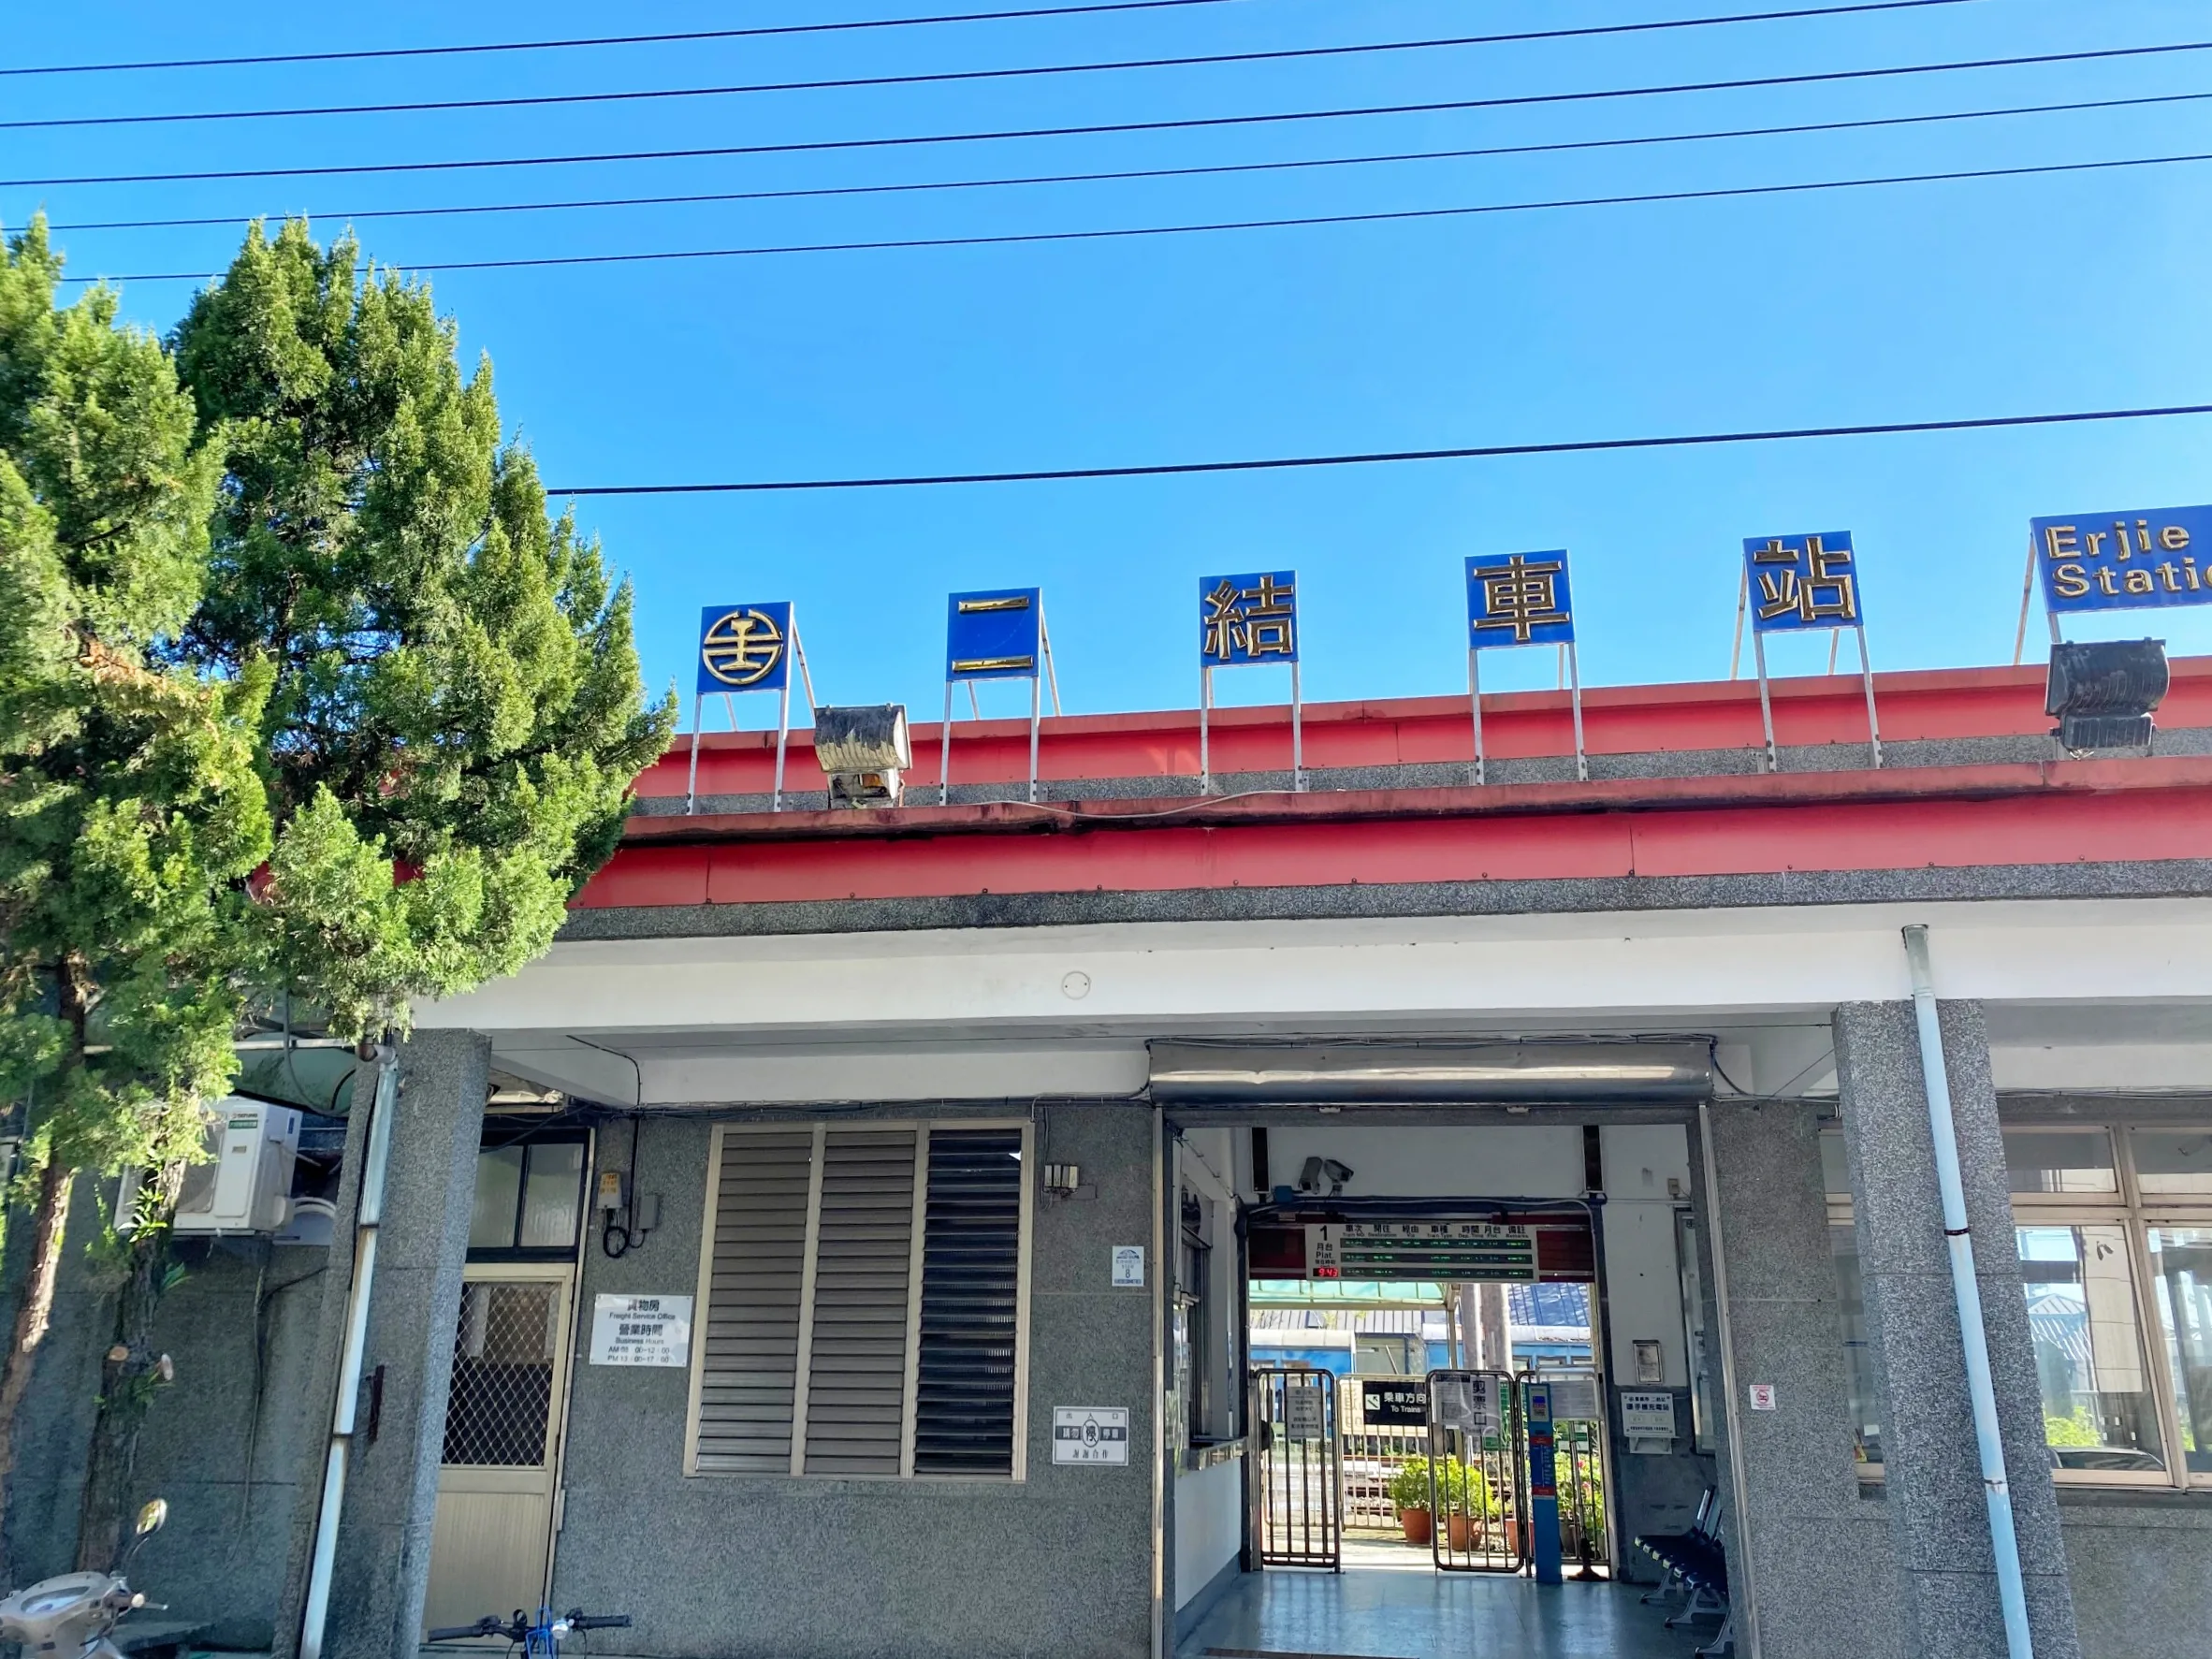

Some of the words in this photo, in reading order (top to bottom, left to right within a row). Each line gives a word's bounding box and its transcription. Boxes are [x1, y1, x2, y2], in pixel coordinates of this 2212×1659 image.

[2045, 519, 2190, 561] Erjie
[2052, 556, 2212, 598] Stati
[1317, 1243, 1333, 1251] 月台
[609, 1312, 632, 1320] Freight
[618, 1323, 663, 1336] 營業時間
[1383, 1391, 1426, 1404] 乘車方向
